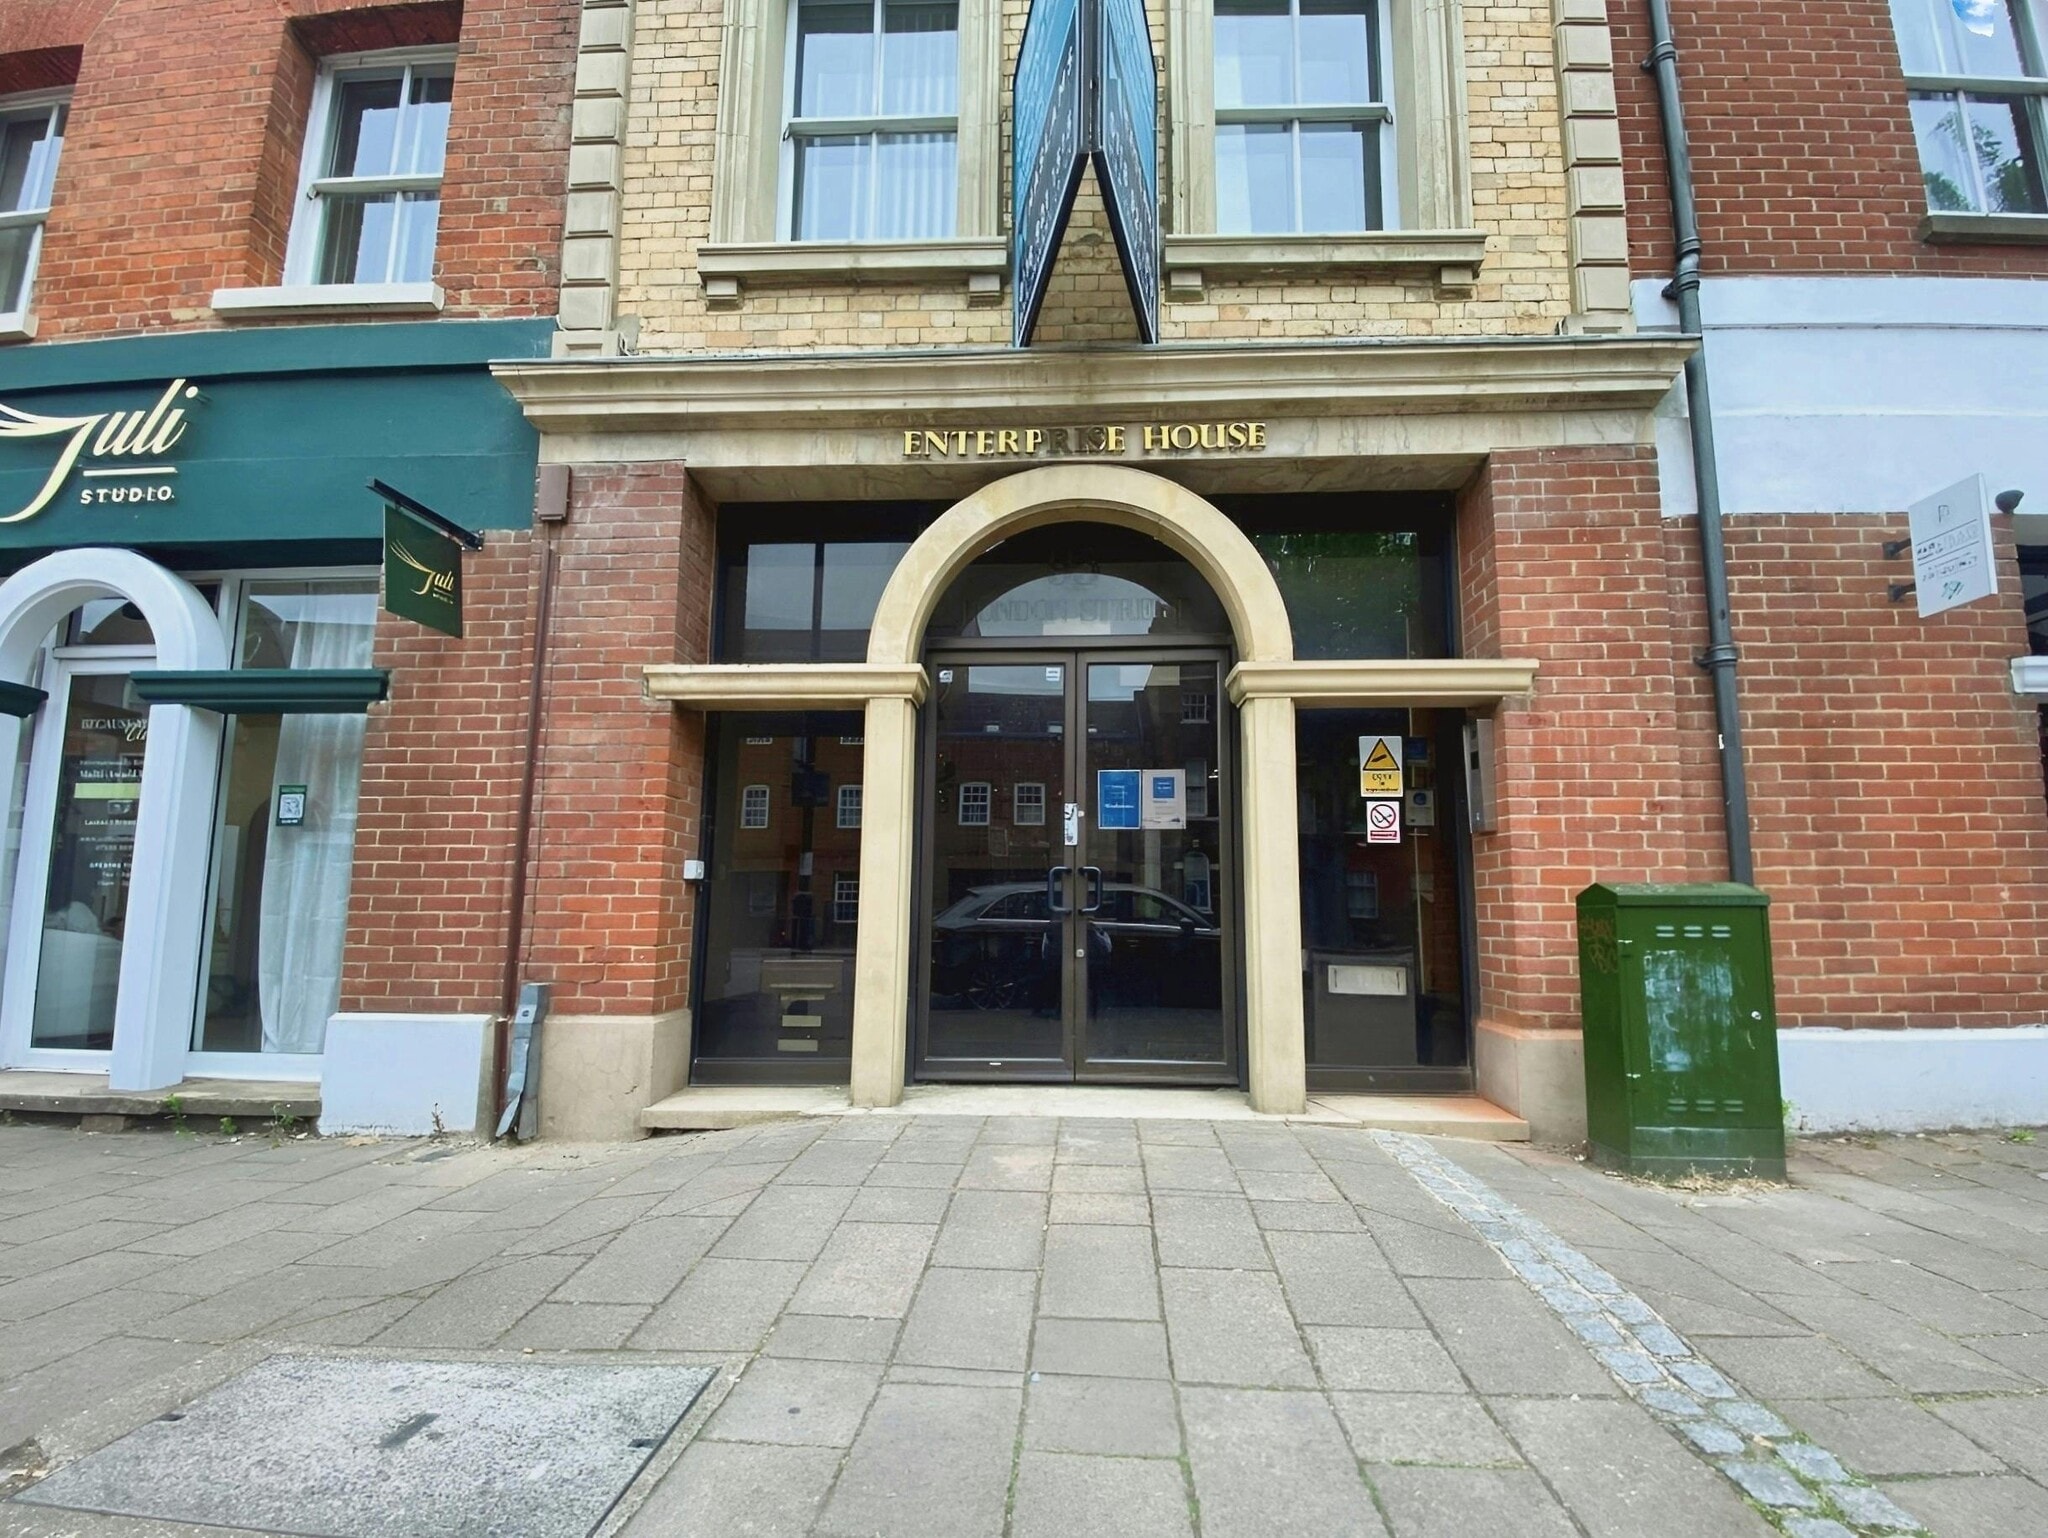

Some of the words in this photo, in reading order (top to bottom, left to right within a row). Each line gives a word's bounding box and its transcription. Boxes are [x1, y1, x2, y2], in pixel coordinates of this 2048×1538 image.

[903, 427, 1125, 457] ENTERPRISE
[1143, 422, 1266, 450] HOUSE
[80, 486, 174, 504] STUDIO
